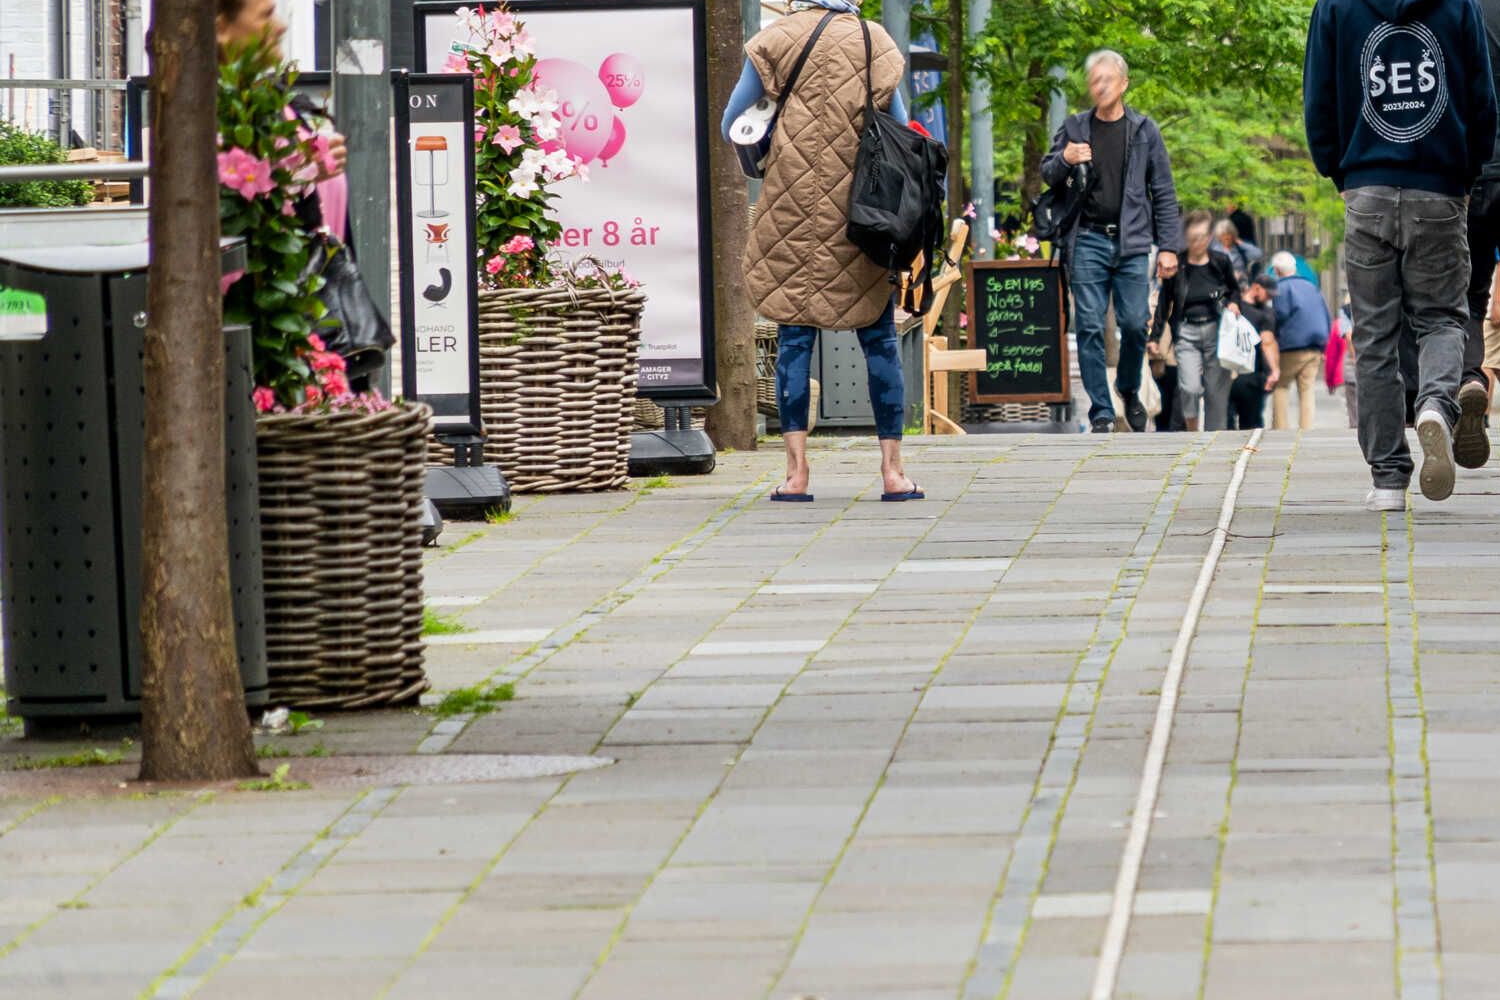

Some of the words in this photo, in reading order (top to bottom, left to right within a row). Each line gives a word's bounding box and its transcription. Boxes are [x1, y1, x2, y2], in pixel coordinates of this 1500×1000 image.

[605, 74, 641, 89] 25%
[1369, 60, 1436, 97] SES
[1382, 100, 1426, 112] 2023/2024
[602, 220, 621, 247] 8
[630, 216, 660, 247] år
[416, 336, 457, 353] LER
